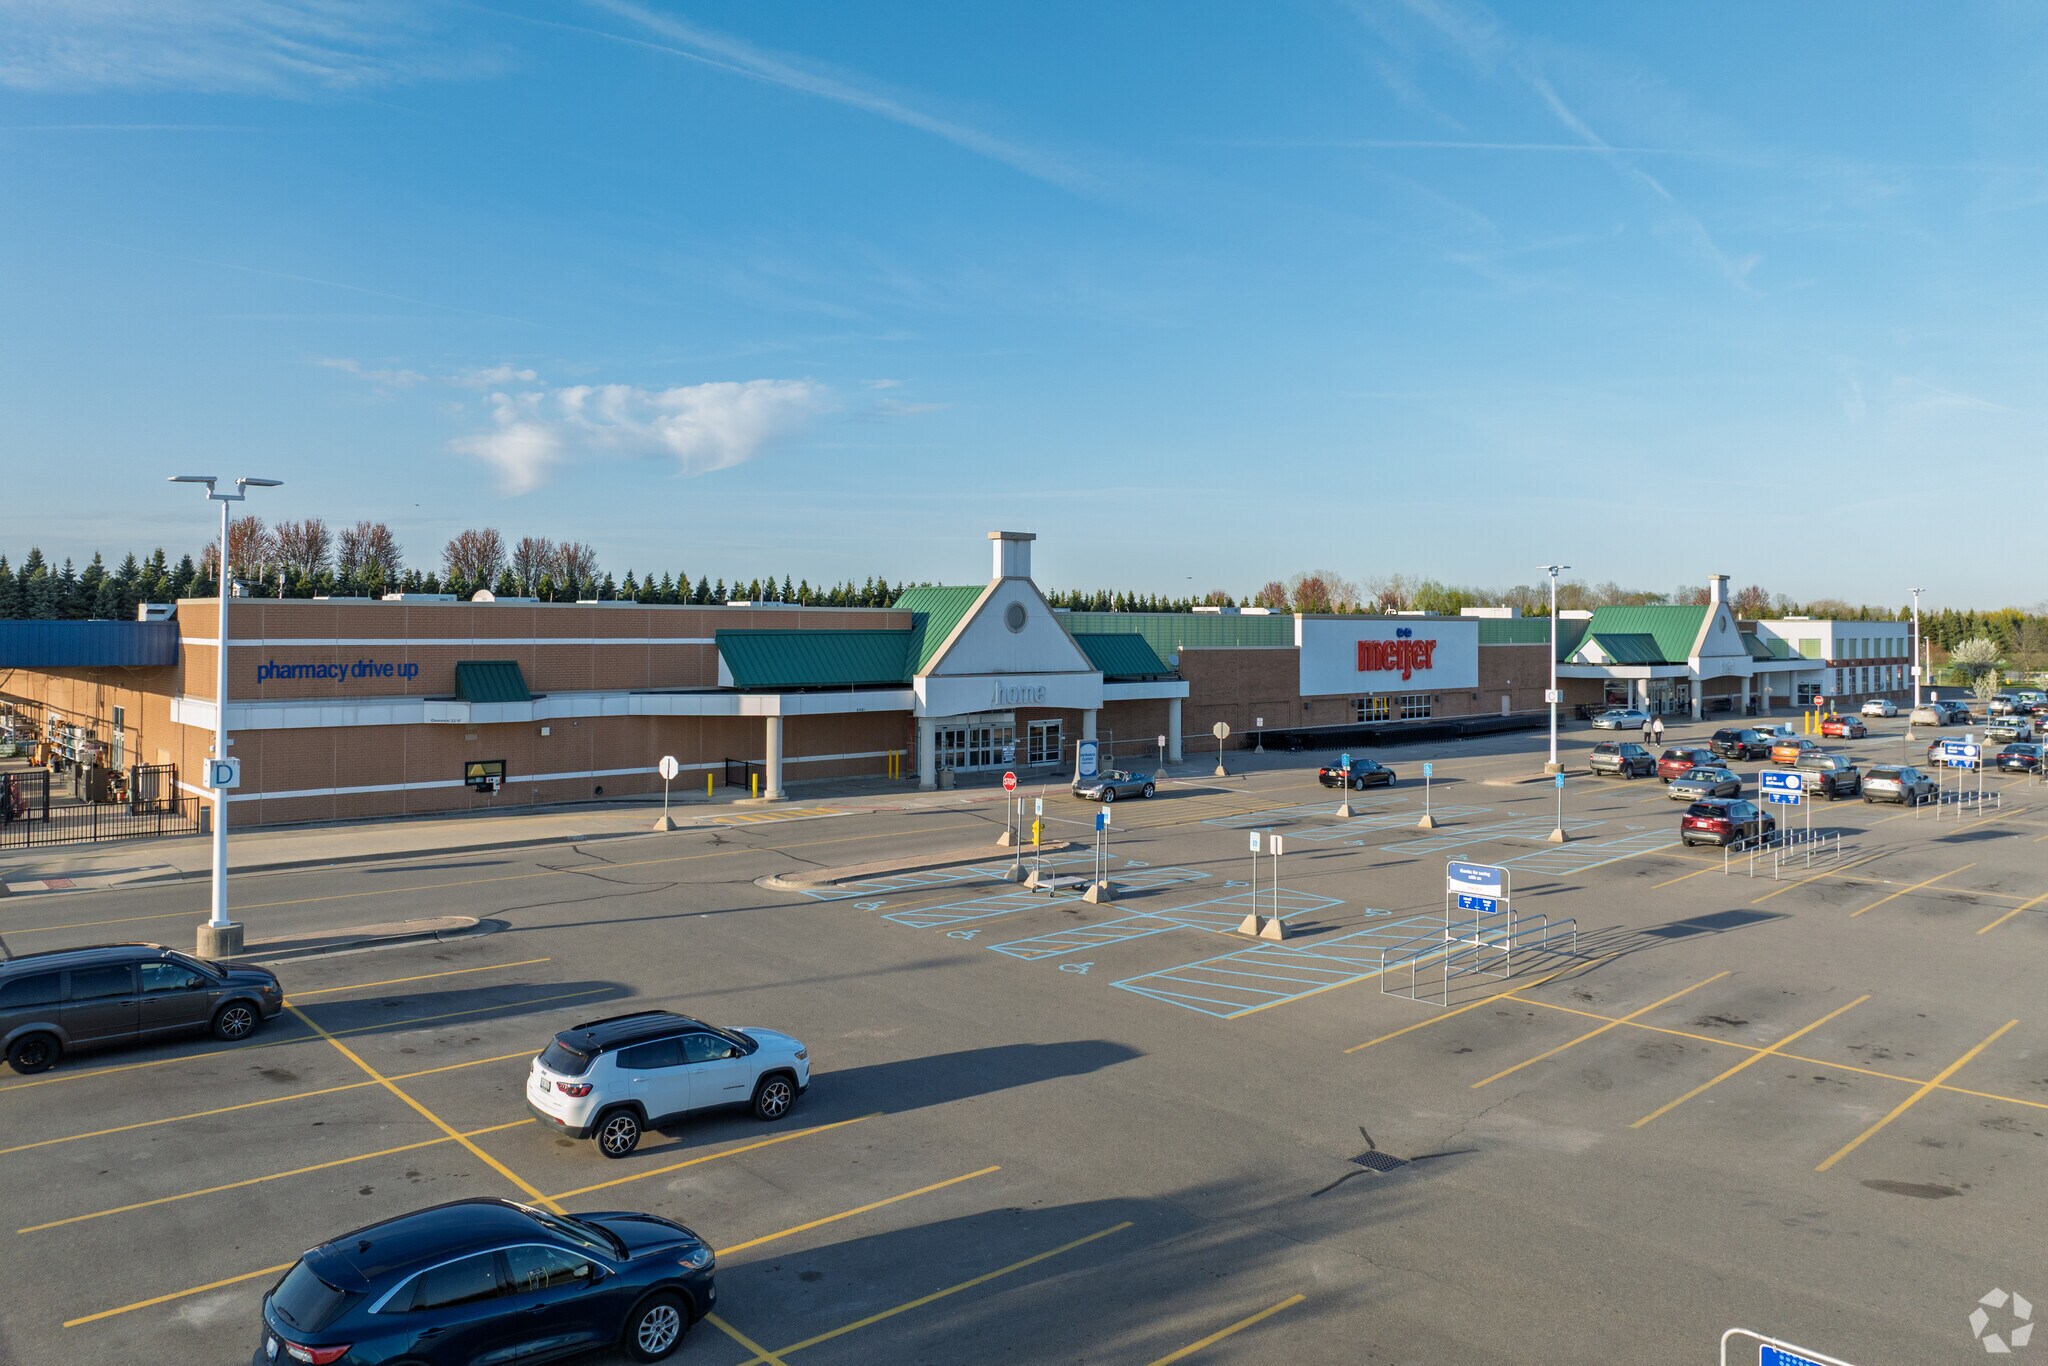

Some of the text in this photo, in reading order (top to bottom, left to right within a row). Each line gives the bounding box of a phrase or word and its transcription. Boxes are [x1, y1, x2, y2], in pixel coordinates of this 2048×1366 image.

[1357, 628, 1437, 681] meijer
[257, 659, 419, 684] pharmacy drive up
[994, 680, 1047, 705] home
[1548, 691, 1555, 701] C
[216, 764, 233, 785] D
[1003, 777, 1016, 786] STOP
